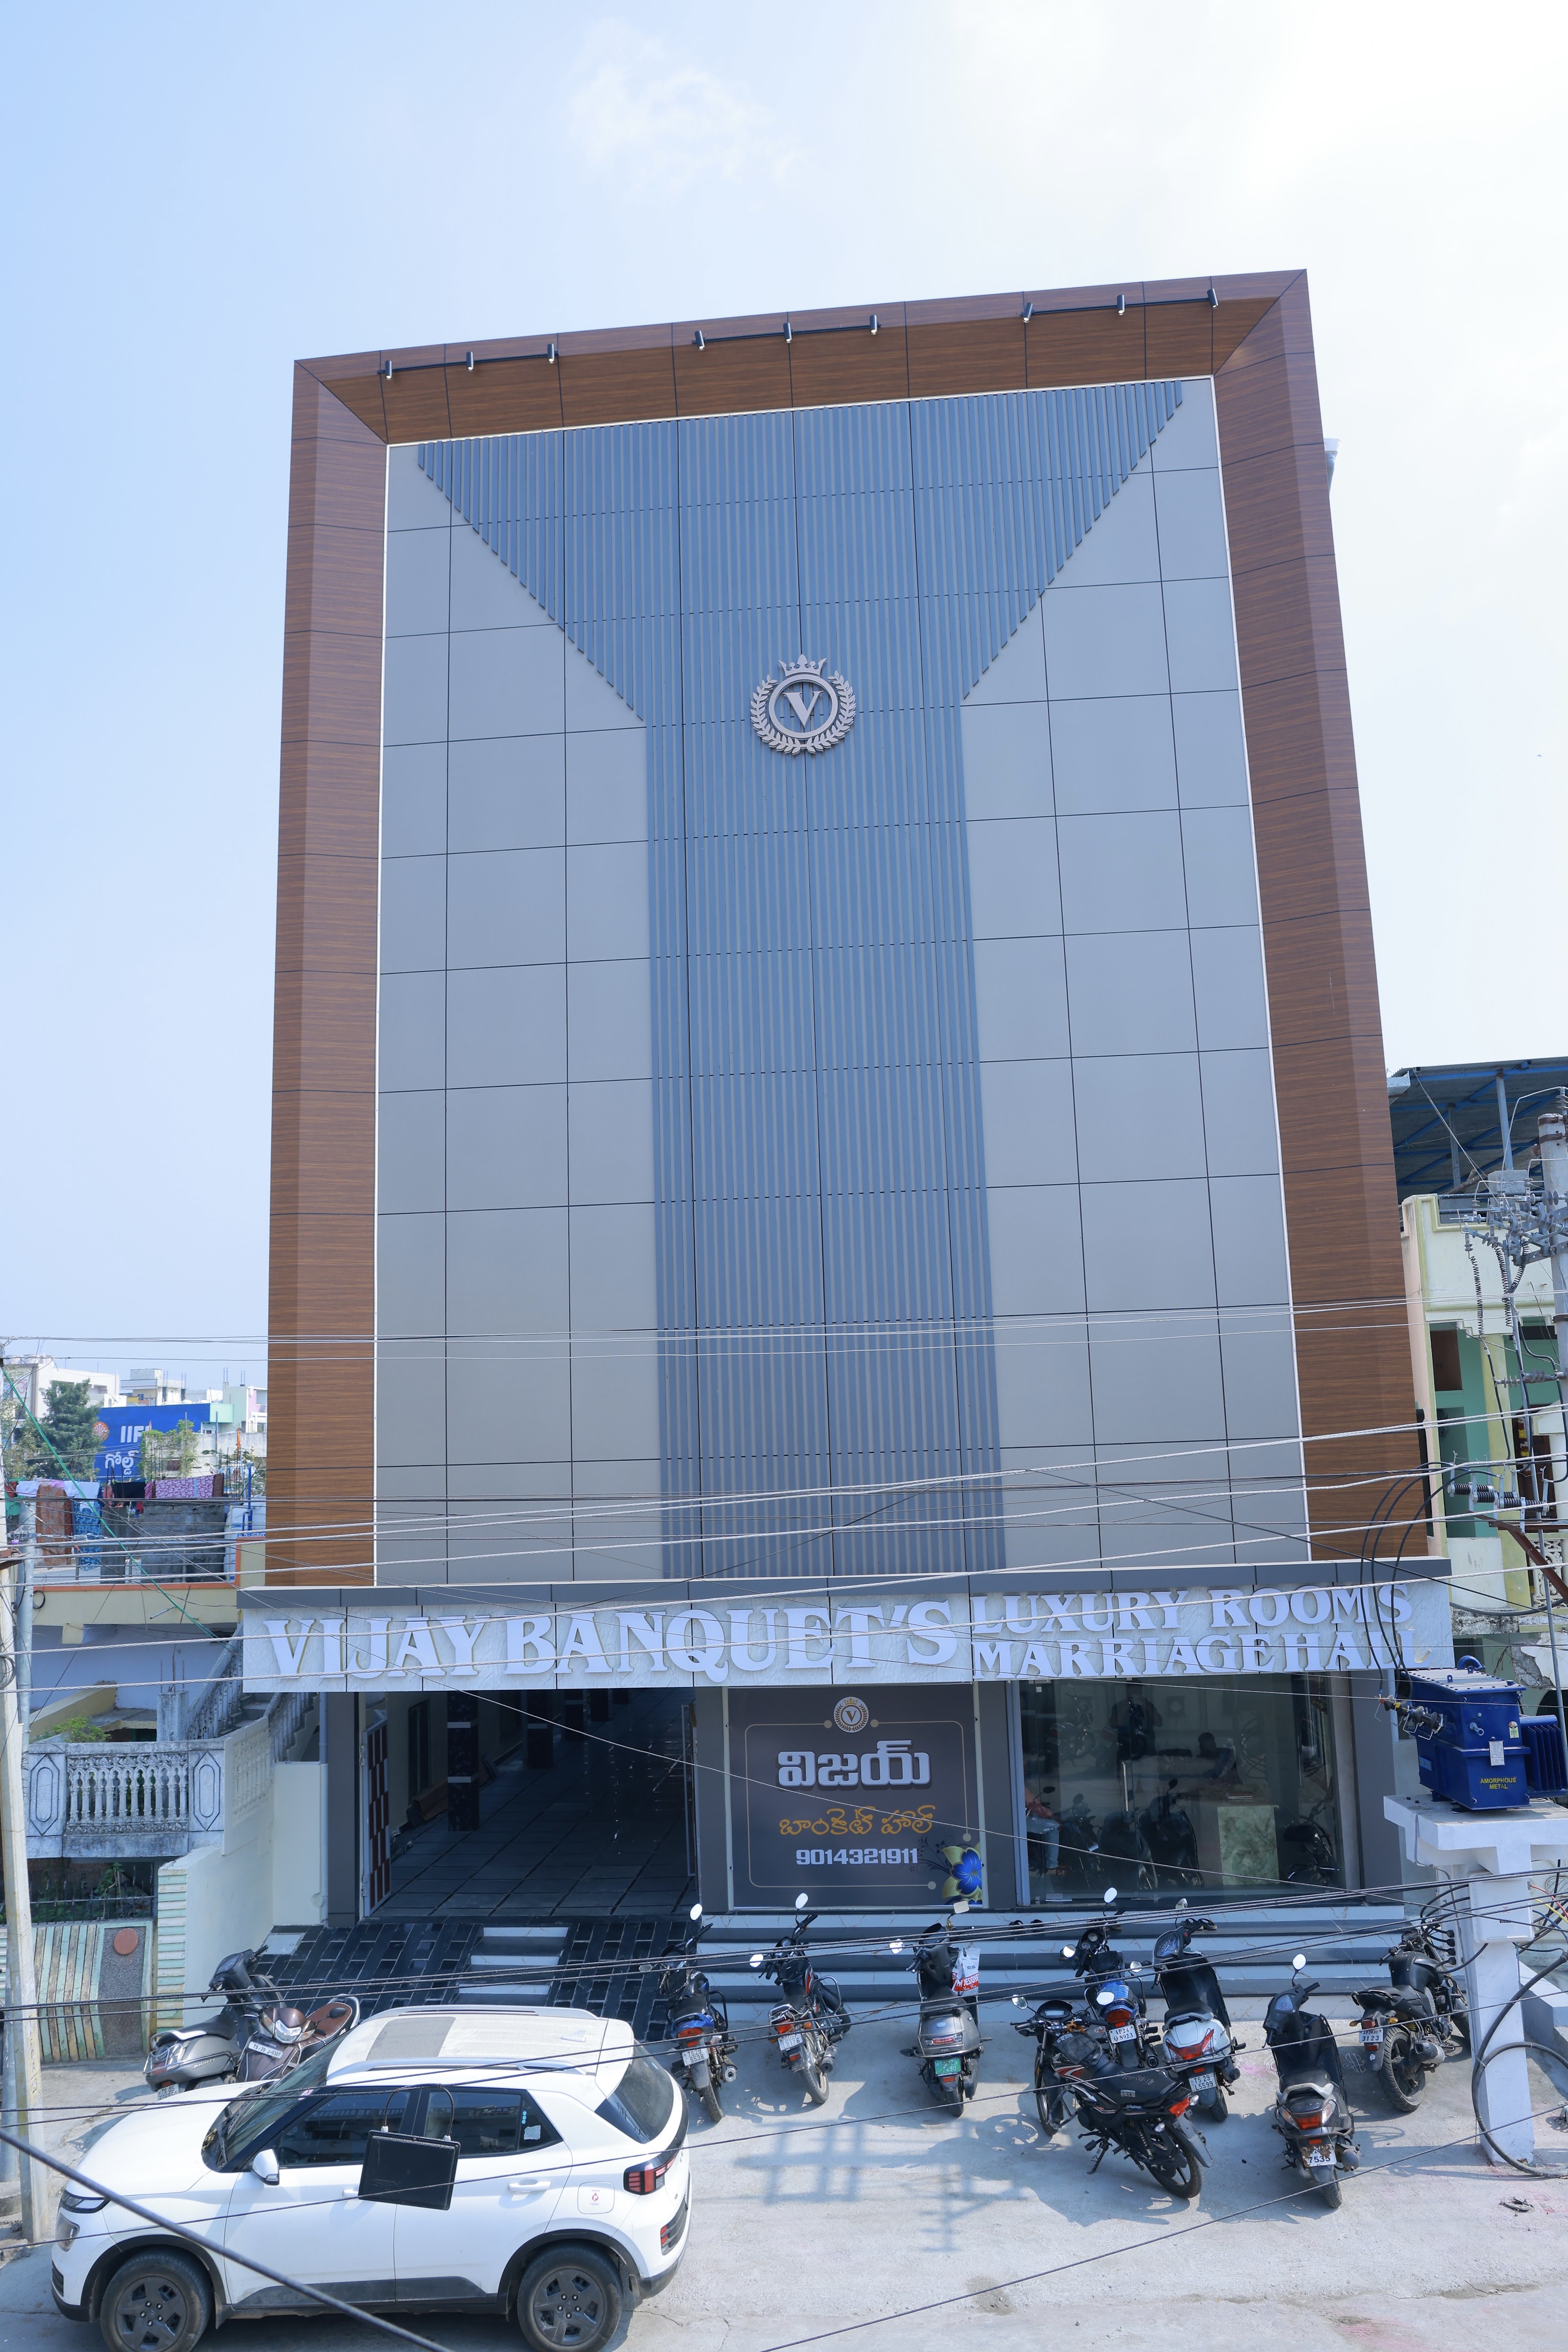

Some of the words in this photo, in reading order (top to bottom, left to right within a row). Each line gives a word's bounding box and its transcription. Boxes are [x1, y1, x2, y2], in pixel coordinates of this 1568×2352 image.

[782, 690, 824, 728] V
[121, 1425, 149, 1443] IIF
[972, 1591, 1192, 1634] LUXURY
[1208, 1583, 1413, 1628] ROOMS
[263, 1615, 491, 1679] VIJAY
[503, 1600, 958, 1683] BANQUET'S
[778, 1740, 931, 1787] విజయ్
[796, 1848, 918, 1865] 9014321911
[690, 2054, 704, 2062] 5538
[1195, 2081, 1213, 2090] L5599
